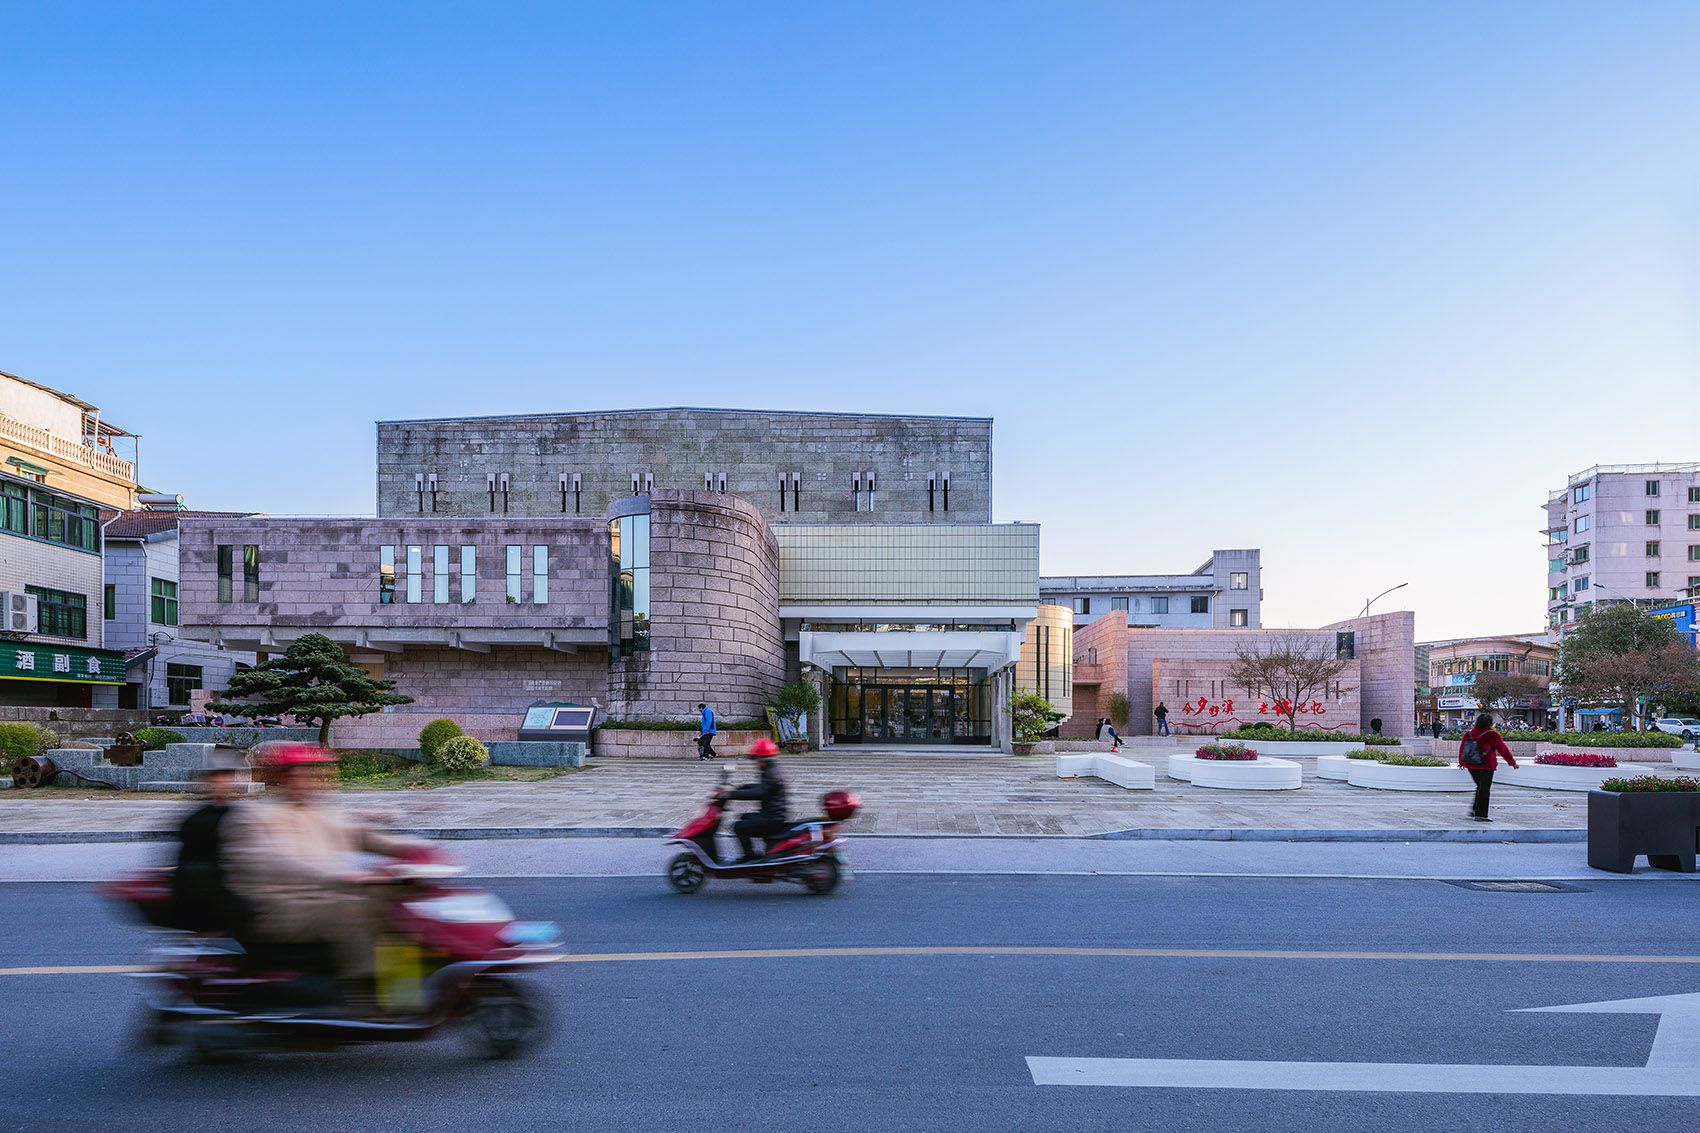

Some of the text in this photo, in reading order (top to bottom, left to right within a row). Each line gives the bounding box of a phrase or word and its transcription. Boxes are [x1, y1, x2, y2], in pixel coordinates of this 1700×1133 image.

[1182, 697, 1326, 718] 今夕好溪 老城记忆
